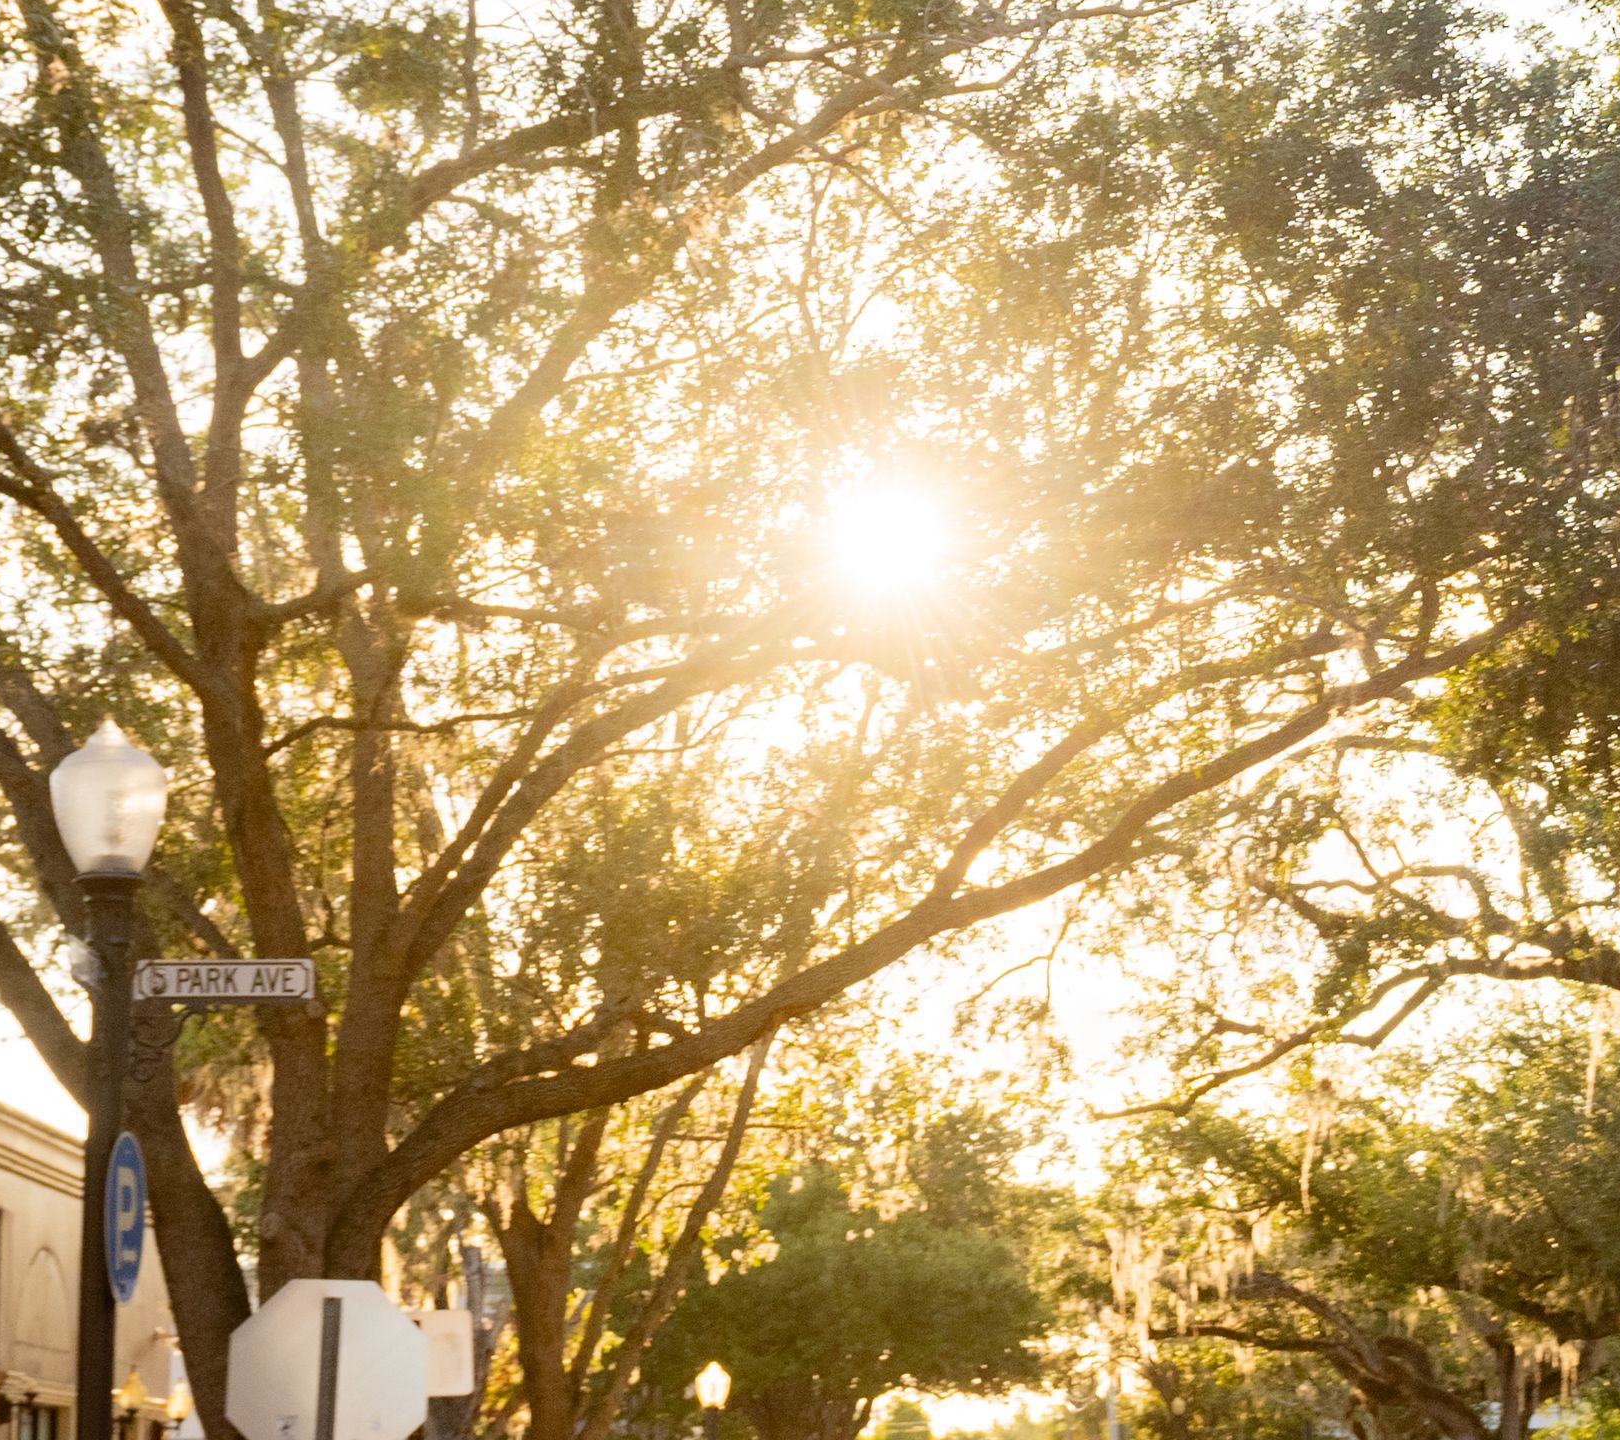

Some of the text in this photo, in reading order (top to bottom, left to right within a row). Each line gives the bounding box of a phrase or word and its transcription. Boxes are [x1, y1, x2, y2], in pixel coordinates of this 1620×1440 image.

[176, 967, 239, 994] PARK
[250, 967, 296, 993] AVE
[115, 1166, 138, 1270] P
